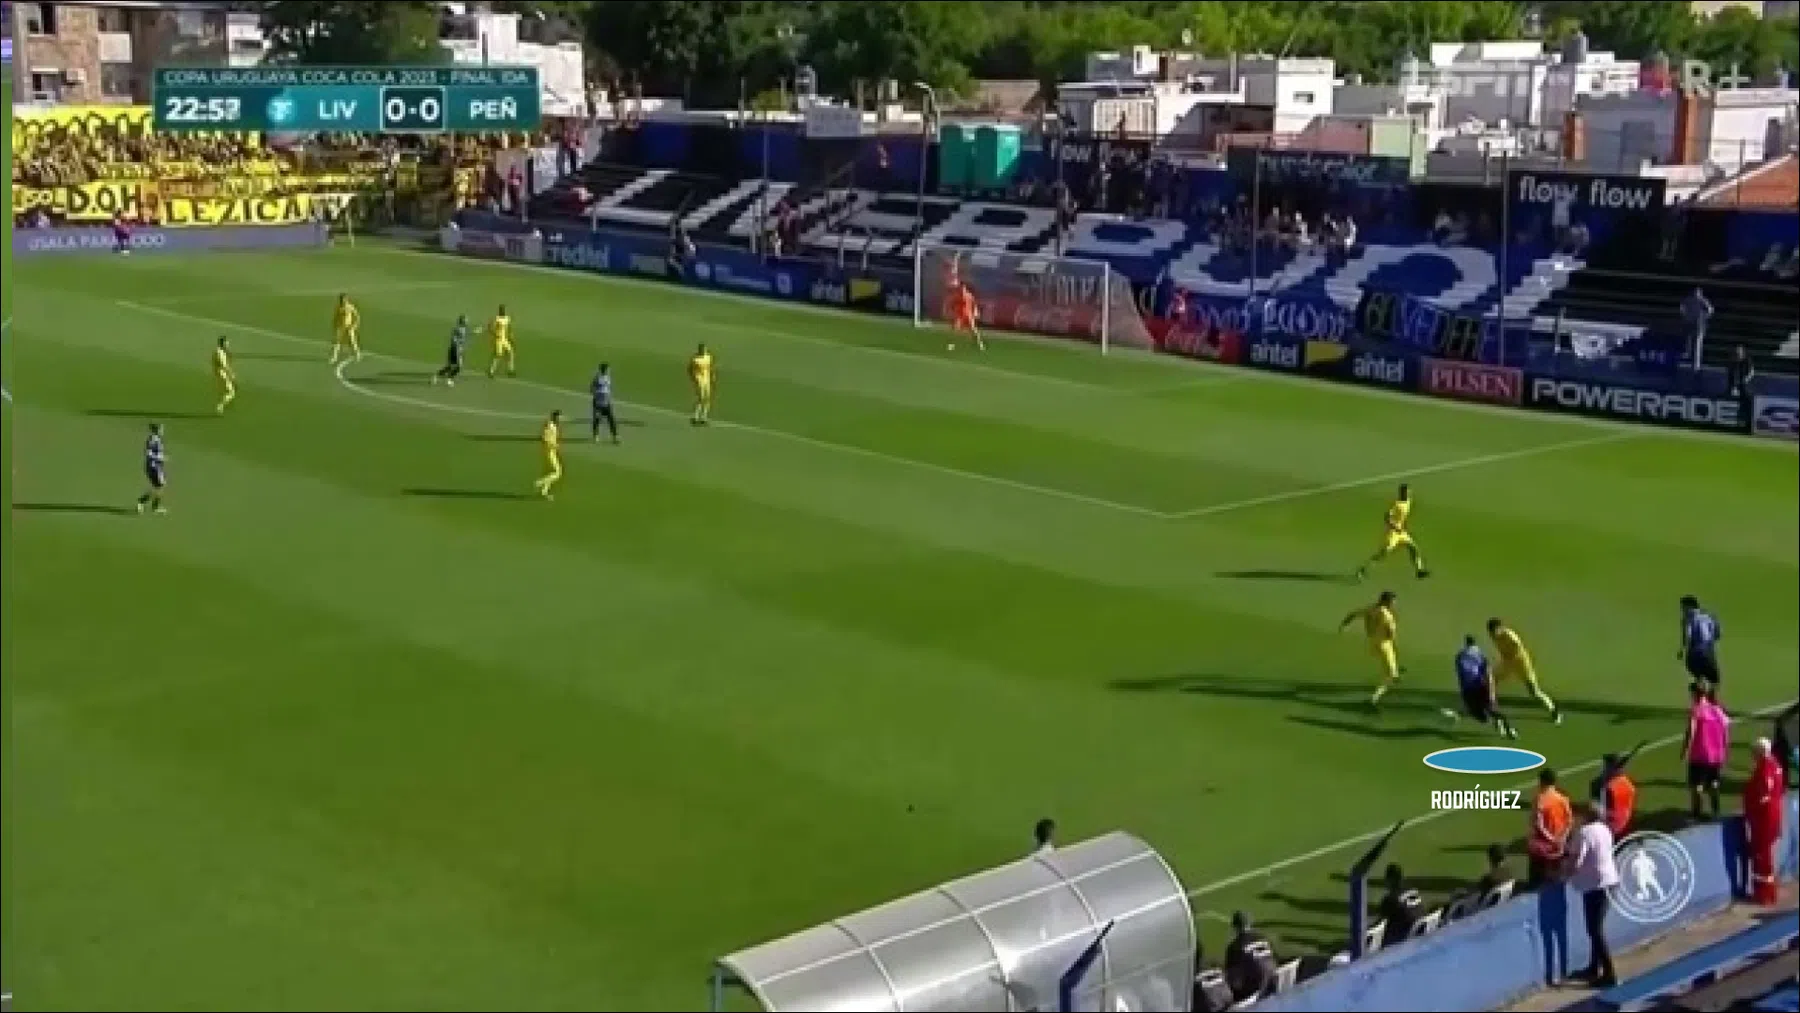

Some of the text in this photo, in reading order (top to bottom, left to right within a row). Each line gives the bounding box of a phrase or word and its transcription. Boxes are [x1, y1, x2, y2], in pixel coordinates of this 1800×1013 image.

[1520, 175, 1652, 209] flow flow
[1252, 339, 1299, 368] antel
[1353, 353, 1404, 383] antel
[1431, 366, 1513, 398] PILSEN
[1532, 377, 1742, 427] POWERADE
